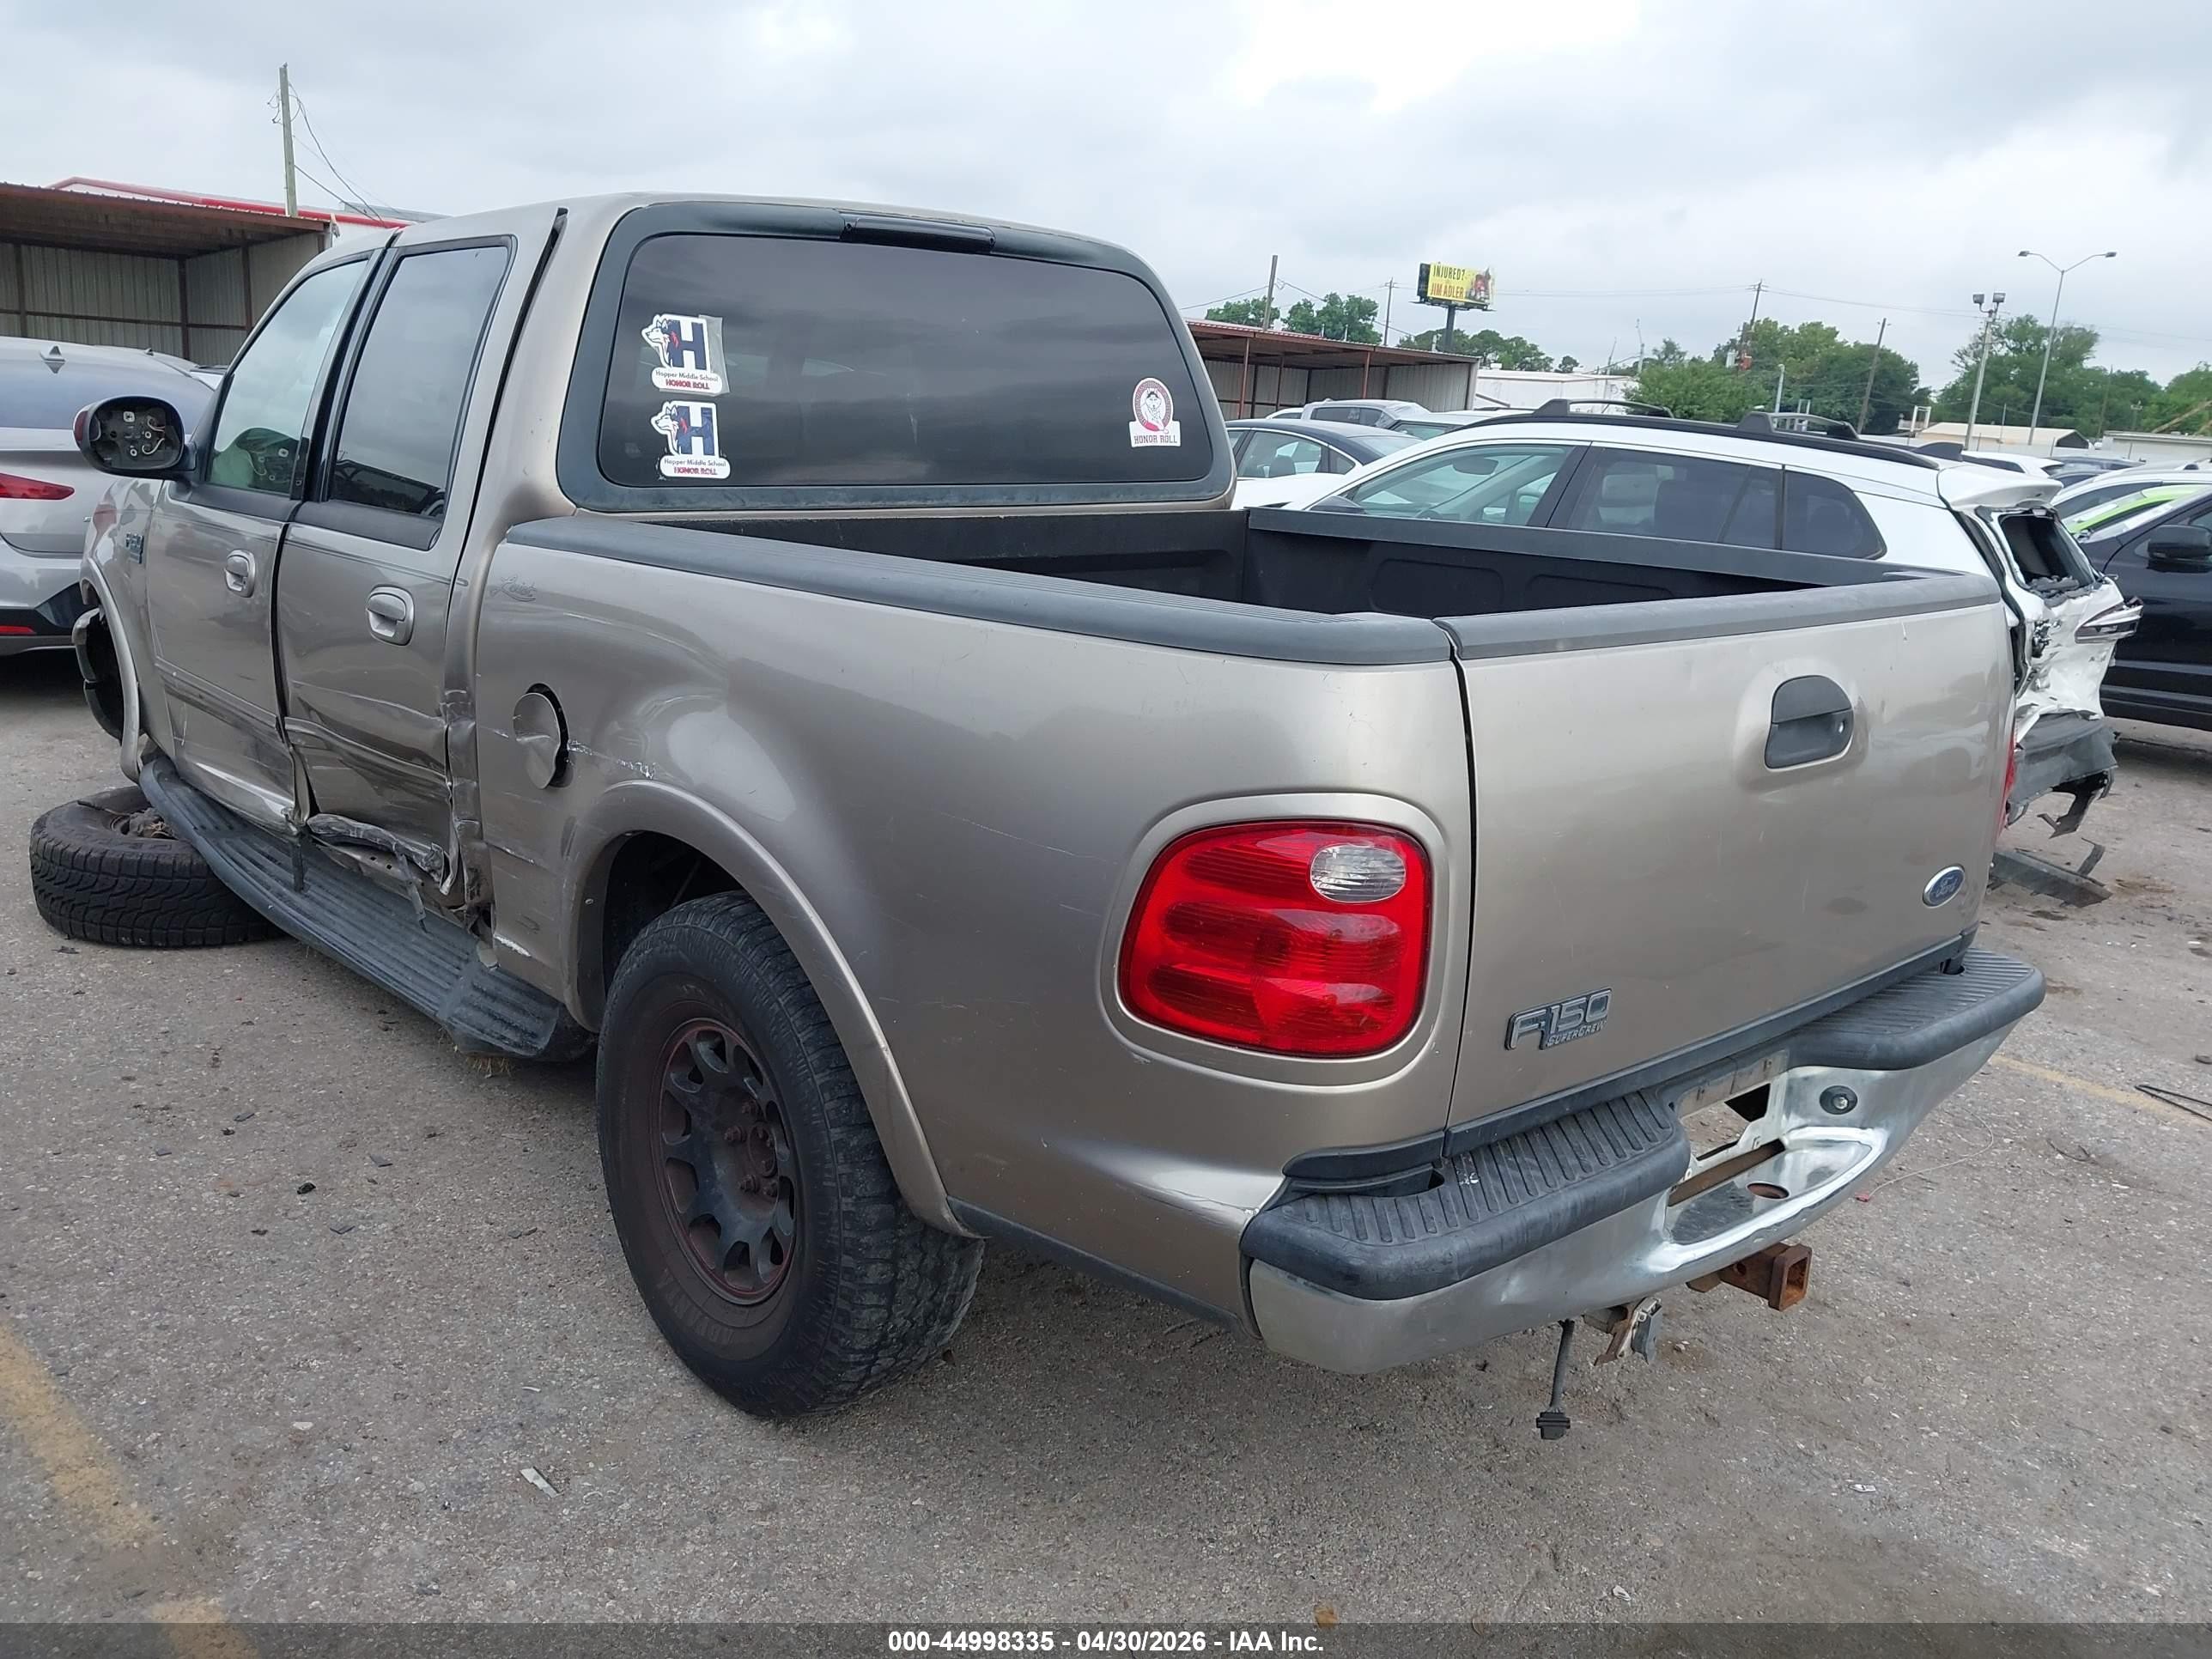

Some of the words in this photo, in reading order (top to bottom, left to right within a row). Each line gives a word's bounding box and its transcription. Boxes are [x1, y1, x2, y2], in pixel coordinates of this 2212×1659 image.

[1432, 264, 1466, 281] INJURED?
[1430, 283, 1443, 297] JIM
[1443, 283, 1464, 300] ADLER
[679, 372, 698, 380] Middle
[699, 373, 719, 382] School
[665, 379, 691, 388] HONOR
[692, 380, 710, 390] ROLL
[1133, 434, 1158, 445] HONOR
[1160, 434, 1177, 444] ROLL
[708, 459, 726, 467] School
